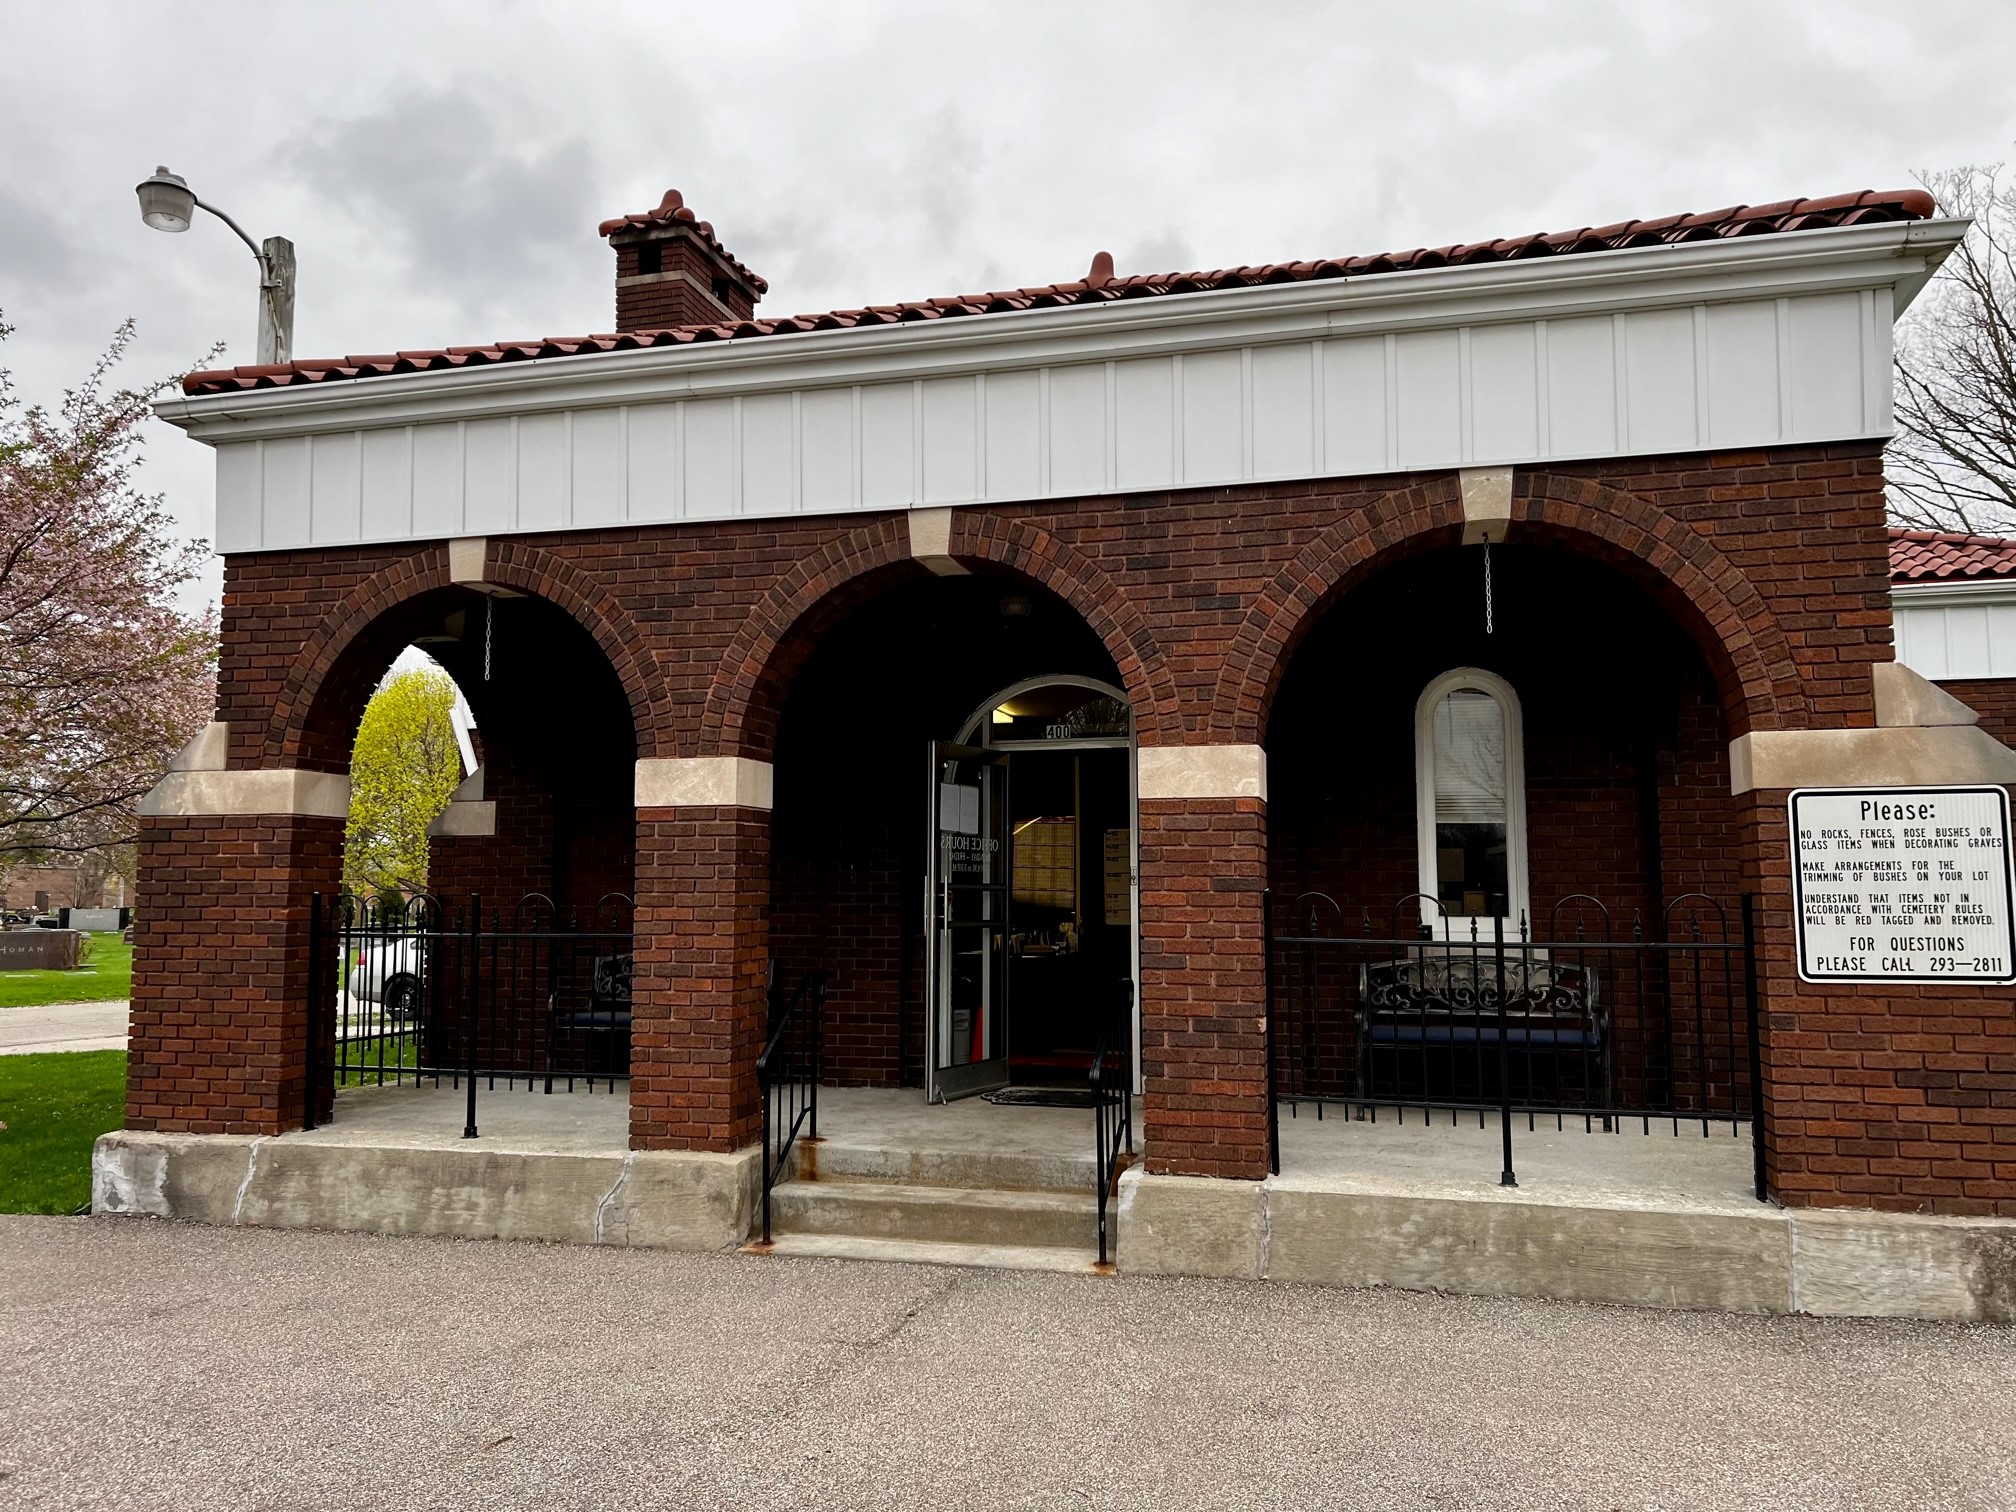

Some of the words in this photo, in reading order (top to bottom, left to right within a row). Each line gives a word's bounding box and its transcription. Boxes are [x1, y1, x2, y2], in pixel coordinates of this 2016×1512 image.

[1047, 725, 1070, 739] 400
[1861, 801, 1935, 820] Please:
[1800, 830, 1811, 839] NO
[1822, 829, 1852, 839] ROCKS,
[1861, 829, 1895, 839] FENCES,
[1904, 829, 1926, 837] ROSE
[1936, 828, 1970, 837] BUSHES
[1980, 827, 1991, 836] OR
[1802, 841, 1827, 850] GLASS
[1838, 840, 1861, 849] ITEMS
[1872, 840, 1895, 849] WHEN
[1905, 839, 1958, 848] DECORATING
[1969, 838, 2002, 847] GRAVES
[1803, 862, 1825, 871] MAKE
[1835, 861, 1902, 871] ARRANGEMENTS
[1912, 861, 1929, 870] FOR
[1939, 861, 1954, 870] THE
[1803, 873, 1843, 882] TRIMMING
[1853, 873, 1863, 881] OF
[1874, 872, 1907, 881] BUSHES
[1917, 872, 1928, 881] ON
[1939, 872, 1962, 880] YOUR
[1973, 871, 1988, 880] LOT
[1805, 894, 1859, 903] UNDERSTAND
[1869, 894, 1889, 903] THAT
[1899, 894, 1923, 903] ITEMS
[1934, 894, 1950, 902] NOT
[1961, 894, 1969, 902] IN
[1806, 905, 1861, 914] ACCORDANCE
[1872, 905, 1891, 914] WITH
[1902, 905, 1944, 914] CEMETERY
[1956, 905, 1983, 913] RULES
[1806, 916, 1825, 925] WILL
[1836, 916, 1845, 925] BE
[1856, 916, 1871, 924] RED
[1882, 916, 1913, 924] TAGGED
[1924, 916, 1941, 924] AND
[1952, 916, 1994, 924] REMOVED.
[1850, 937, 1875, 950] FOR
[1891, 937, 1964, 951] QUESTIONS
[1818, 957, 1866, 971] PLEASE
[1883, 958, 1914, 971] CALL
